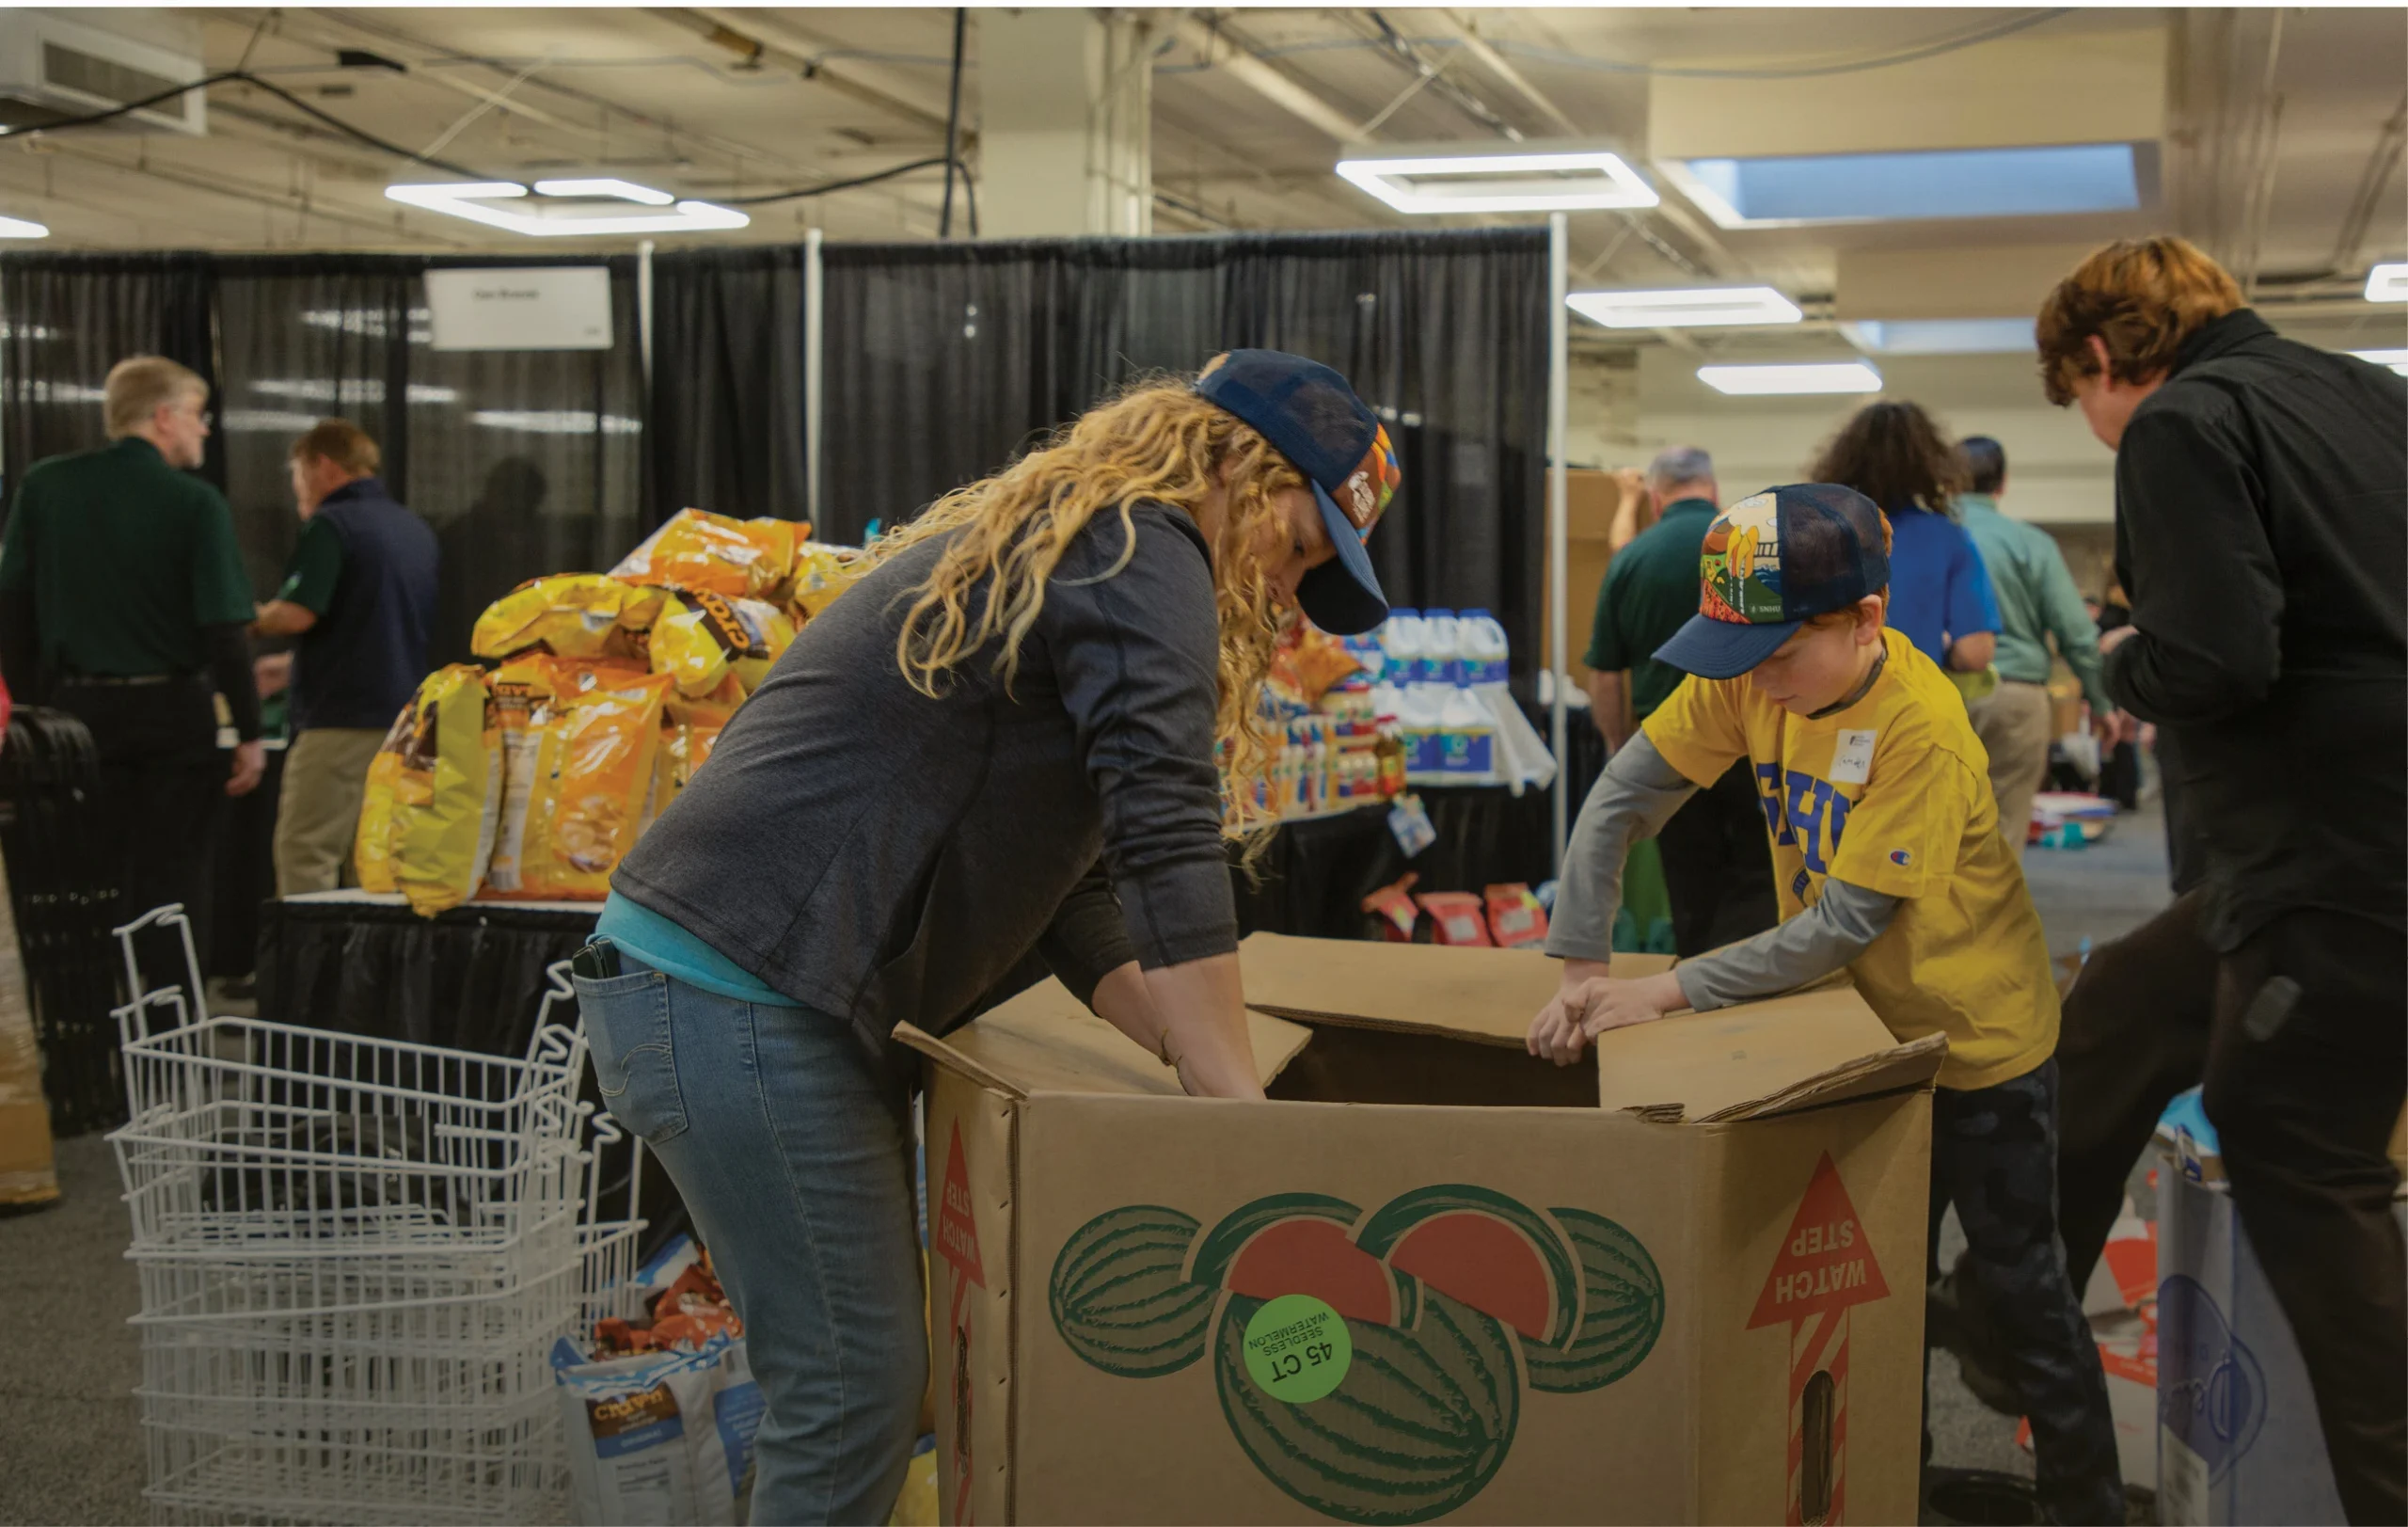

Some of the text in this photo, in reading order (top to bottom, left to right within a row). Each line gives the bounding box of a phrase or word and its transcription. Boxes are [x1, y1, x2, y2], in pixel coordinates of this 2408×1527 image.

[1758, 605, 1781, 613] SNHU
[946, 1179, 970, 1217] STEP
[943, 1215, 976, 1264] WATCH
[1791, 1218, 1854, 1257] STEP
[1776, 1258, 1867, 1304] WATCH
[1248, 1312, 1330, 1350] WATERMELON
[1262, 1326, 1323, 1357] SEEDLESS
[1272, 1342, 1333, 1383] 45 CT
